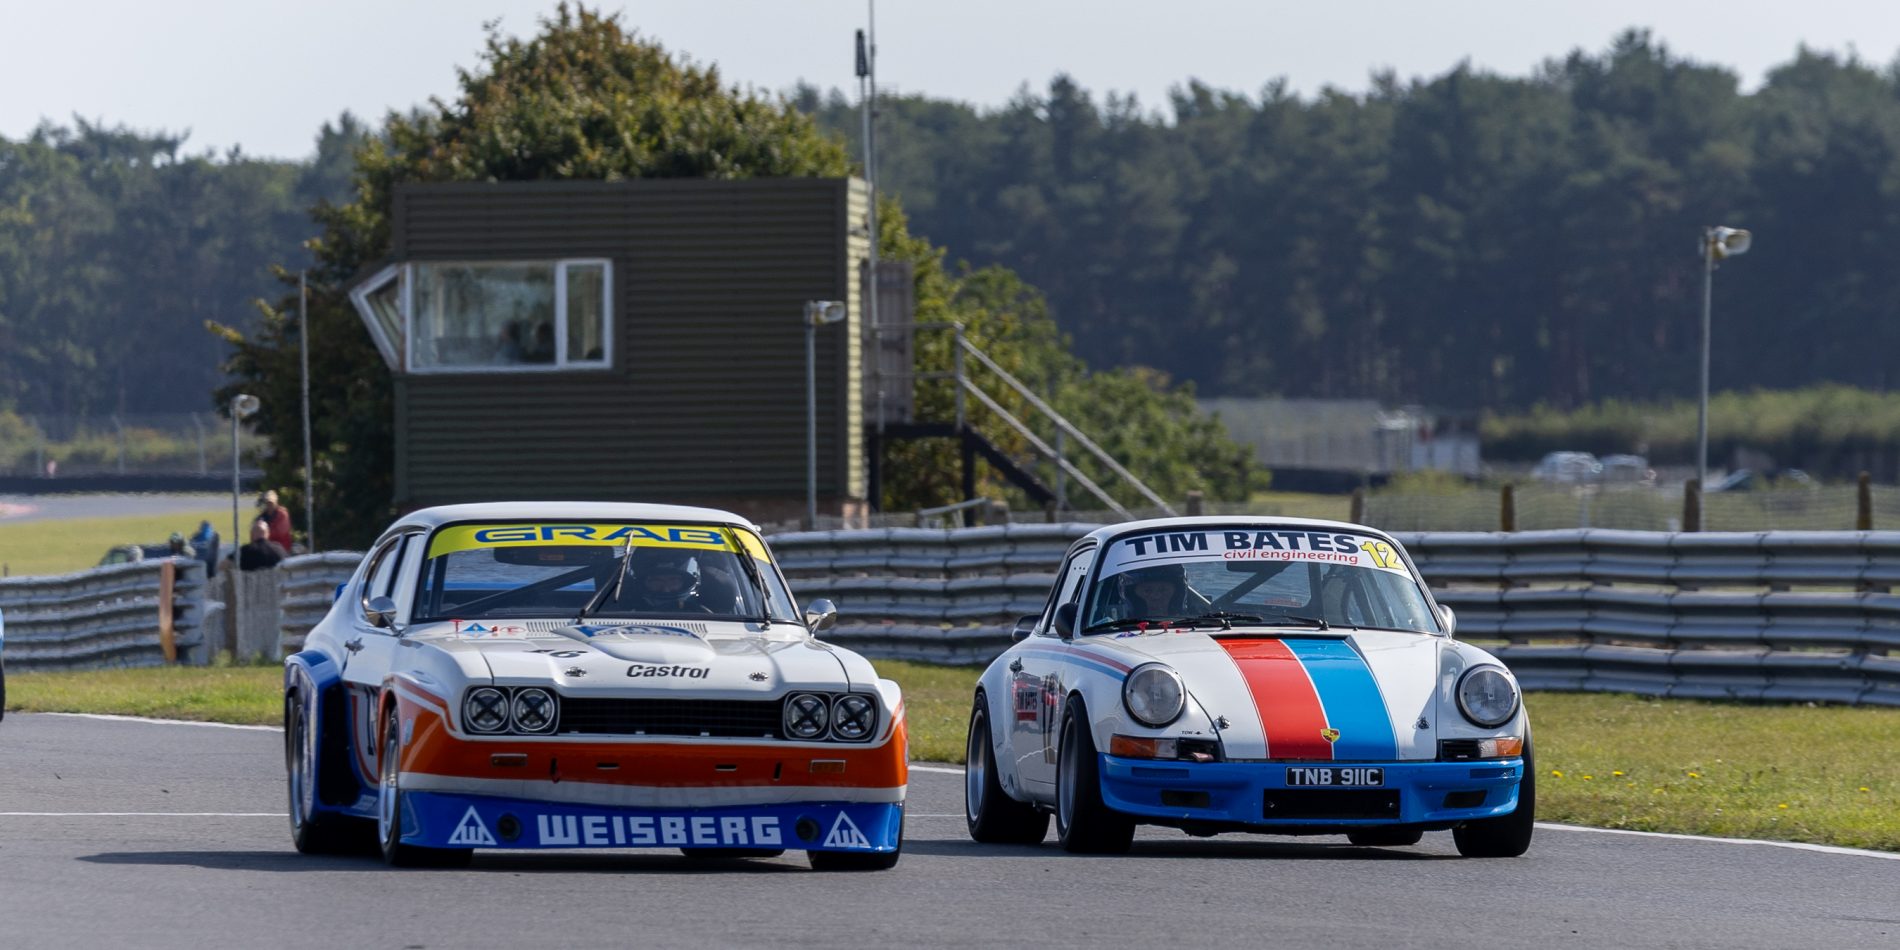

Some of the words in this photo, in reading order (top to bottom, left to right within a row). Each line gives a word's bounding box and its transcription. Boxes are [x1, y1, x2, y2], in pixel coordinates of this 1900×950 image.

[475, 526, 726, 545] GRAB
[1125, 532, 1208, 556] TIM
[1223, 532, 1359, 554] BATES
[1224, 549, 1256, 559] civil
[1261, 549, 1358, 565] engineering
[1360, 541, 1406, 571] 12
[626, 664, 710, 679] Castrol
[1291, 768, 1332, 785] TNB
[1341, 768, 1379, 785] 911C
[537, 814, 782, 845] WEISBERG
